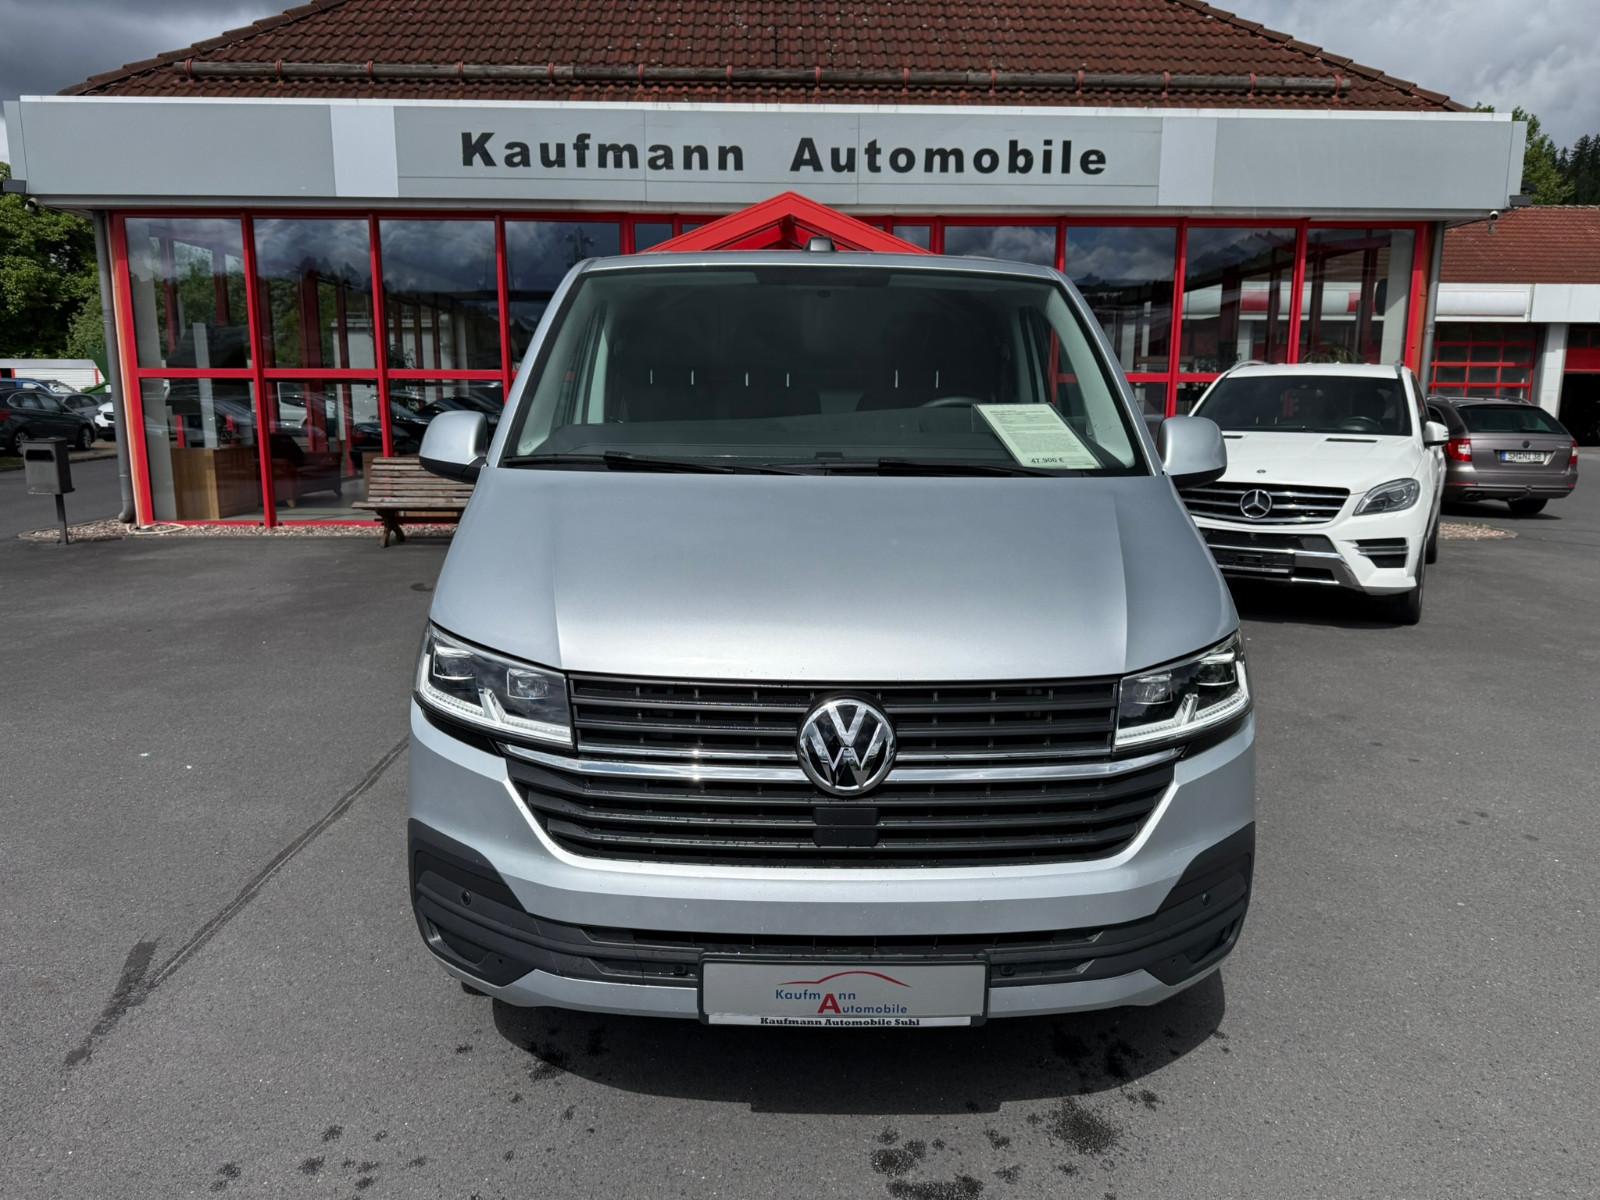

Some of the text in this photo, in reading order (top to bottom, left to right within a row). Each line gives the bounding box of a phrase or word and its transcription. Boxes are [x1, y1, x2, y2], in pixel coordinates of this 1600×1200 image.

[461, 131, 1107, 175] Kaufmann Automobile
[760, 1017, 920, 1027] Kaufmann Automobile Suhl
